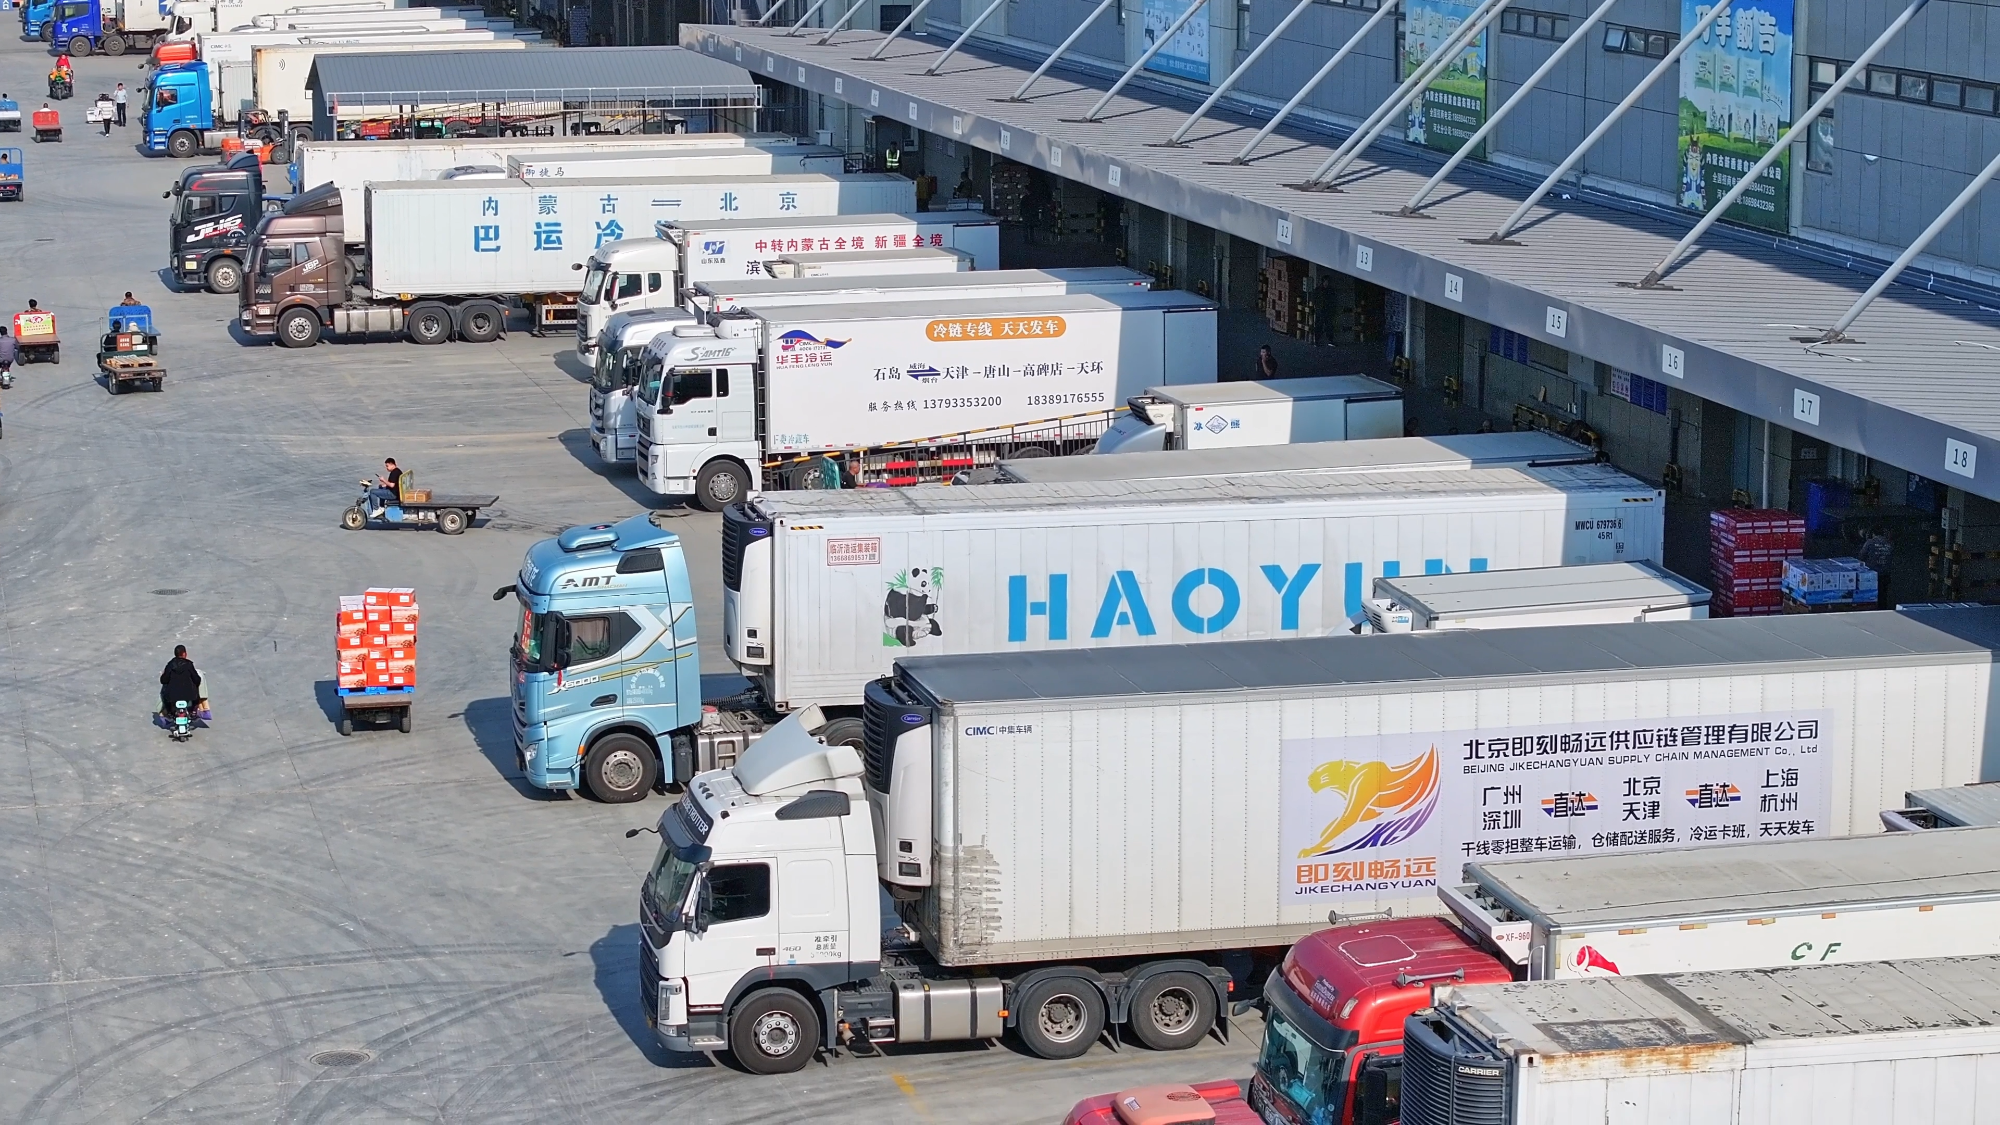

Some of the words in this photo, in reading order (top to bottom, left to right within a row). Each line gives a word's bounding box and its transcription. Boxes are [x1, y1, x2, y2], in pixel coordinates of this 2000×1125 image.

[482, 194, 619, 217] 内蒙古
[719, 191, 798, 212] 北京
[186, 214, 243, 243] JH6
[1280, 224, 1289, 239] 12
[755, 235, 865, 254] 中转内蒙古全境
[874, 232, 943, 250] 新疆全境
[1360, 251, 1369, 266] 13
[1449, 279, 1458, 295] 14
[933, 321, 993, 338] 冷链专线
[1000, 319, 1059, 337] 天天发车
[1551, 313, 1562, 330] 15
[776, 351, 832, 365] 华丰冷运
[908, 362, 926, 370] 威海
[1668, 352, 1679, 370] 16
[873, 366, 901, 382] 石岛
[921, 376, 938, 384] 烟台
[867, 400, 918, 413] 服务热线
[923, 396, 1002, 410] 13793353200
[1026, 392, 1105, 407] 18389176555
[1800, 397, 1813, 416] 17
[1953, 447, 1968, 469] 18
[1575, 520, 1594, 530] MWCU
[1598, 531, 1613, 540] 45R1
[558, 574, 617, 589] AMT
[903, 714, 923, 722] Carrier
[965, 725, 995, 736] CIMC
[999, 724, 1033, 735] 中集车辆
[1463, 720, 1818, 760] 北京即刻畅远供应链管理有限公司
[1463, 763, 1505, 774] BEIJING
[1509, 757, 1603, 771] JIKECHANGYUAN
[1608, 754, 1650, 765] SUPPLY
[1655, 752, 1689, 762] CHAIN
[1693, 747, 1770, 760] MANAGEMENT
[1800, 745, 1818, 754] Ltd
[1761, 768, 1799, 789] 上海
[1482, 784, 1522, 806] 广州
[1553, 791, 1586, 818] 直达
[1622, 776, 1661, 797] 北京
[1698, 782, 1730, 809] 直达
[1760, 792, 1798, 813] 杭州
[1482, 809, 1521, 831] 深圳
[1622, 800, 1660, 822] 天津
[1296, 856, 1436, 884] 即刻畅远
[1295, 879, 1436, 895] JIKECHANGYUAN
[1505, 931, 1530, 942] XF-960
[1457, 1065, 1501, 1077] CARRIER
